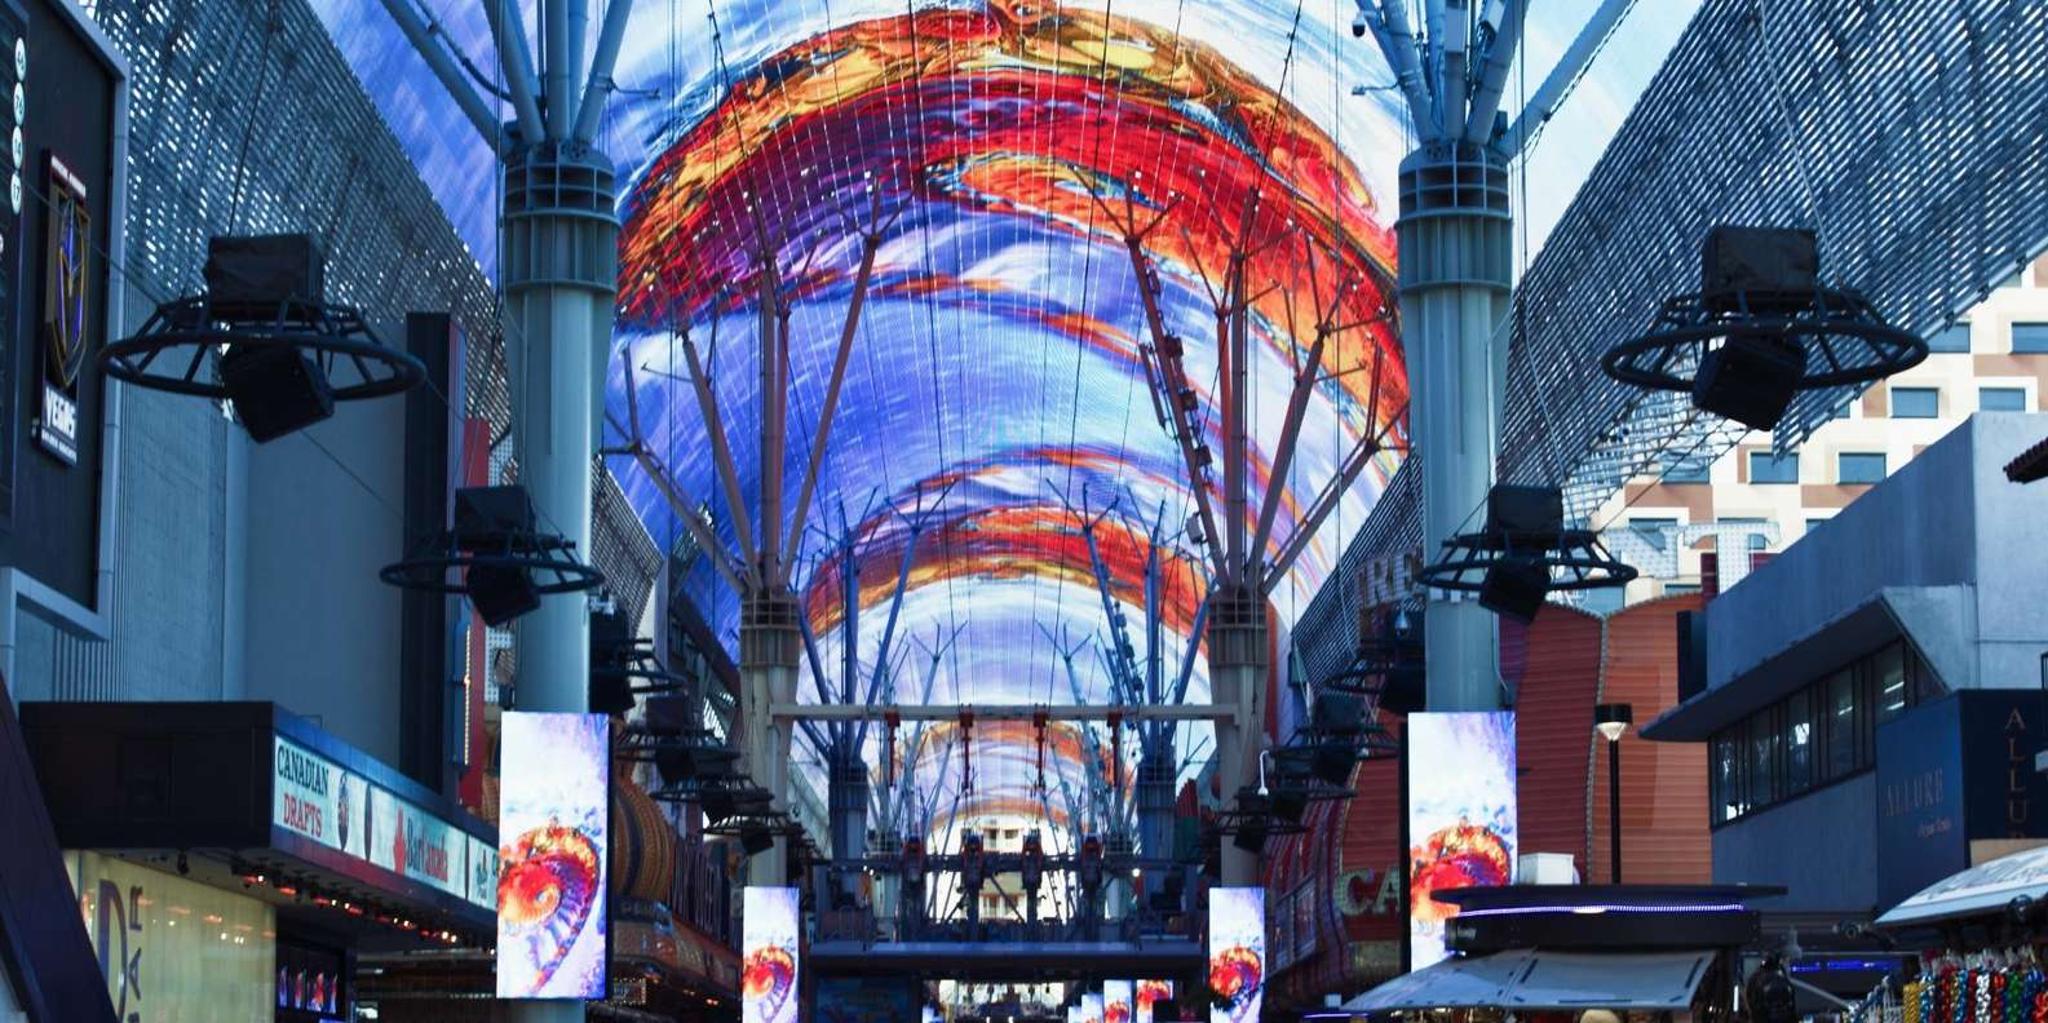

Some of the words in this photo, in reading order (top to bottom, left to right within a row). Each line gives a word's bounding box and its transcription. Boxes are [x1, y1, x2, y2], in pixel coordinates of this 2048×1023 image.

[45, 386, 77, 441] VEGAS
[277, 744, 330, 797] CANADIAN
[2004, 707, 2027, 838] ALLU
[283, 792, 322, 838] DRAFTS
